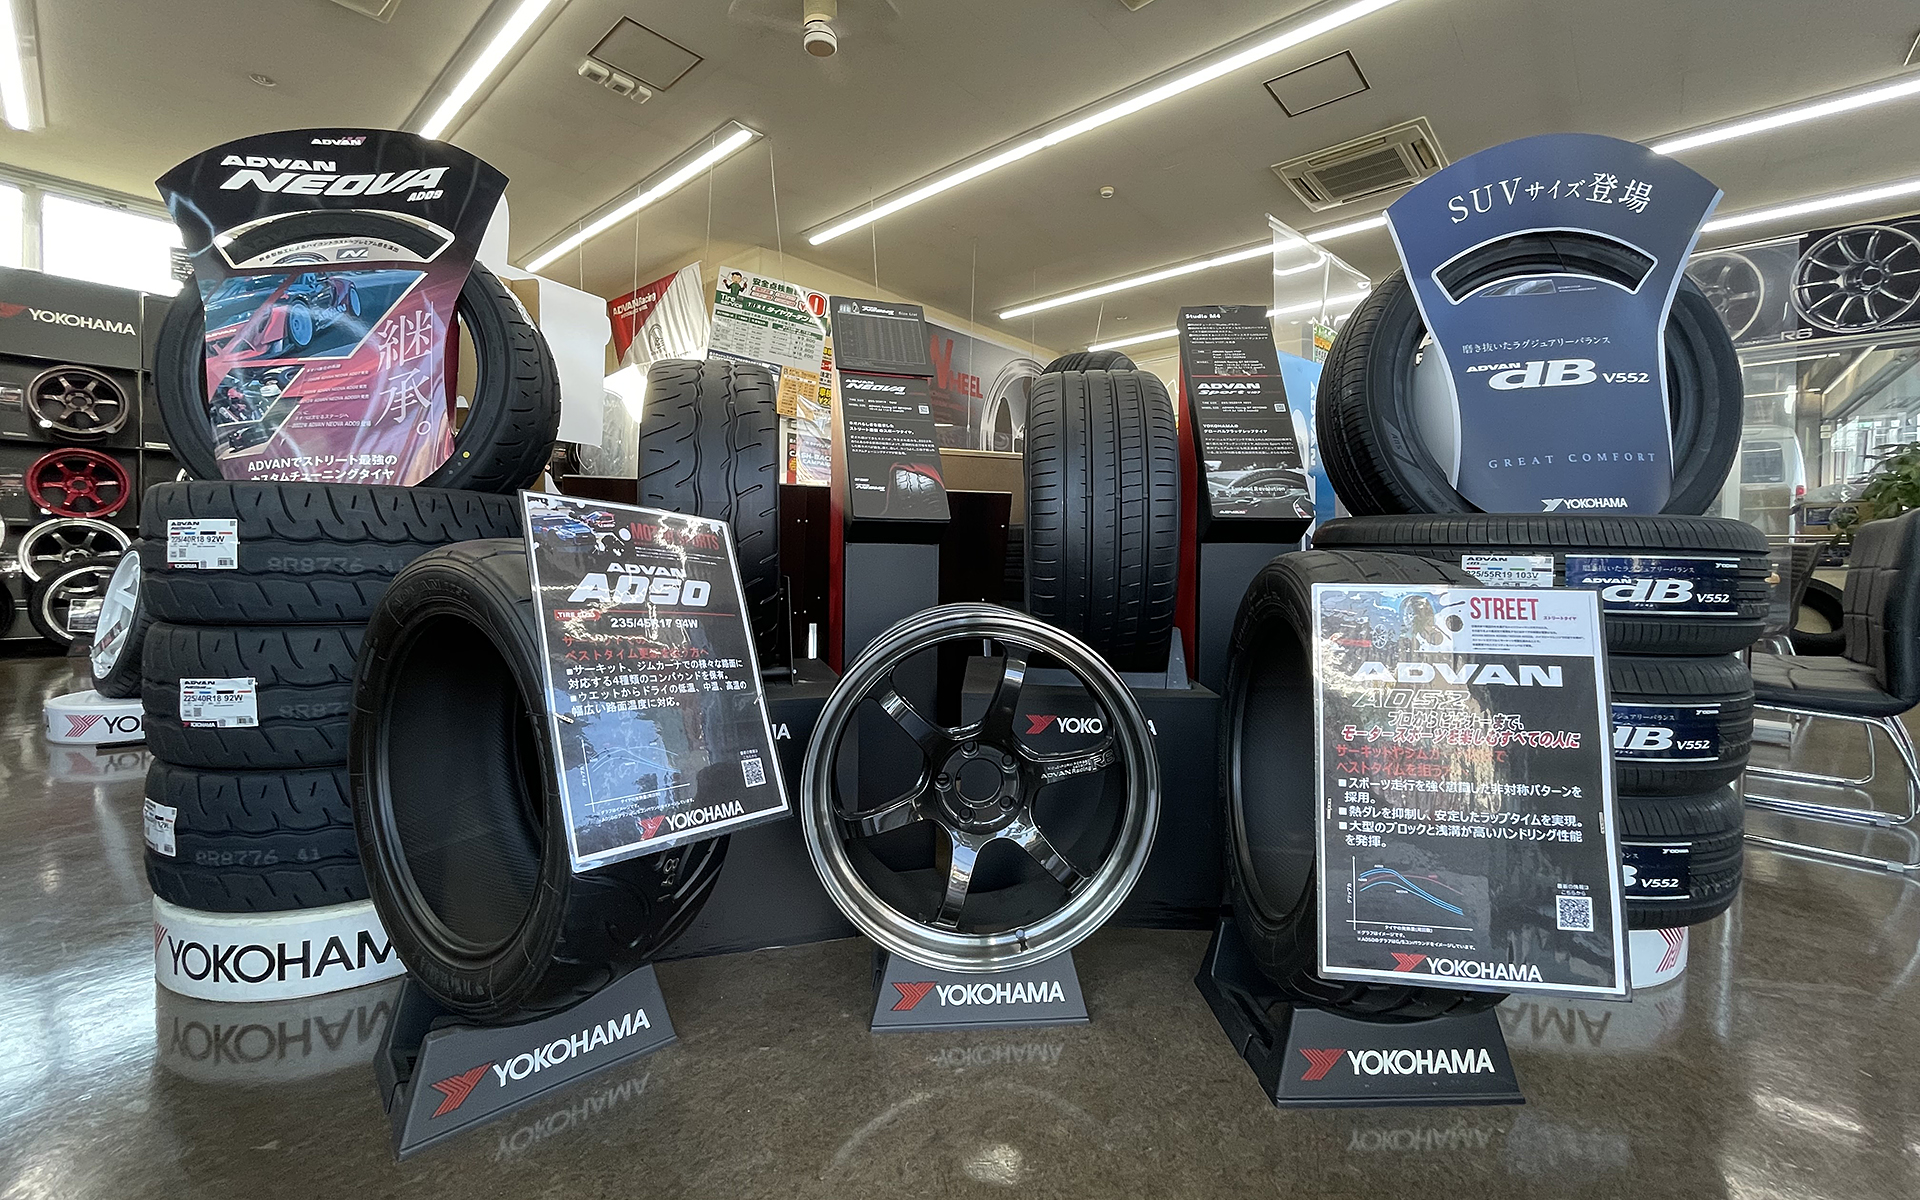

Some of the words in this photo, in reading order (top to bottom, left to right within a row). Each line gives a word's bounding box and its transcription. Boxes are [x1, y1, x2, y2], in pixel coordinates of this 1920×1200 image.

[311, 137, 362, 146] ADVAN
[220, 155, 336, 172] ADVAN
[220, 166, 450, 196] NEOVA
[406, 189, 444, 202] AD09
[1447, 172, 1653, 224] SUVサイズ登場
[720, 293, 736, 302] Tire
[28, 308, 136, 336] YOKOHAMA
[1462, 336, 1611, 354] 磨き抜いたラグジュアリーバランス
[374, 308, 432, 436] 継承。
[1466, 362, 1521, 373] ADVAN
[1488, 358, 1598, 391] dB
[1197, 382, 1261, 390] ADVAN
[1602, 372, 1650, 384] V552
[247, 454, 398, 473] ADVANでストリート最強の
[1488, 455, 1554, 469] GREAT
[1568, 452, 1656, 463] COMFORT
[1563, 498, 1628, 509] YOKOHAMA
[206, 535, 225, 543] 92W
[607, 562, 687, 579] ADVAN
[1516, 571, 1539, 579] 103V
[1601, 578, 1694, 603] dB
[1696, 593, 1730, 604] V552
[1470, 596, 1539, 621] STREET
[610, 618, 673, 629] 235/45R17
[675, 618, 698, 629] 94W
[1351, 661, 1564, 687] ADVAN
[183, 694, 222, 702] 225/40R18
[223, 694, 244, 702] 92W
[571, 697, 681, 718] 幅広い路面温度に対応。
[103, 715, 144, 734] YO
[1055, 717, 1102, 734] YOKO
[1342, 725, 1581, 749] モータースポーツを楽しむすべての人に
[1676, 740, 1710, 751] V552
[1041, 769, 1072, 779] ADVAN
[1344, 790, 1377, 804] 採用。
[665, 799, 745, 831] YOKOHAMA
[1345, 834, 1387, 848] を発揮。
[1642, 878, 1680, 888] V552
[167, 929, 398, 984] YOKOHAM
[1426, 956, 1543, 982] YOKOHAMA
[935, 980, 1066, 1006] YOKOHAMA
[492, 1008, 651, 1088] YOKOHAMA
[1346, 1048, 1496, 1076] YOKOHAMA
